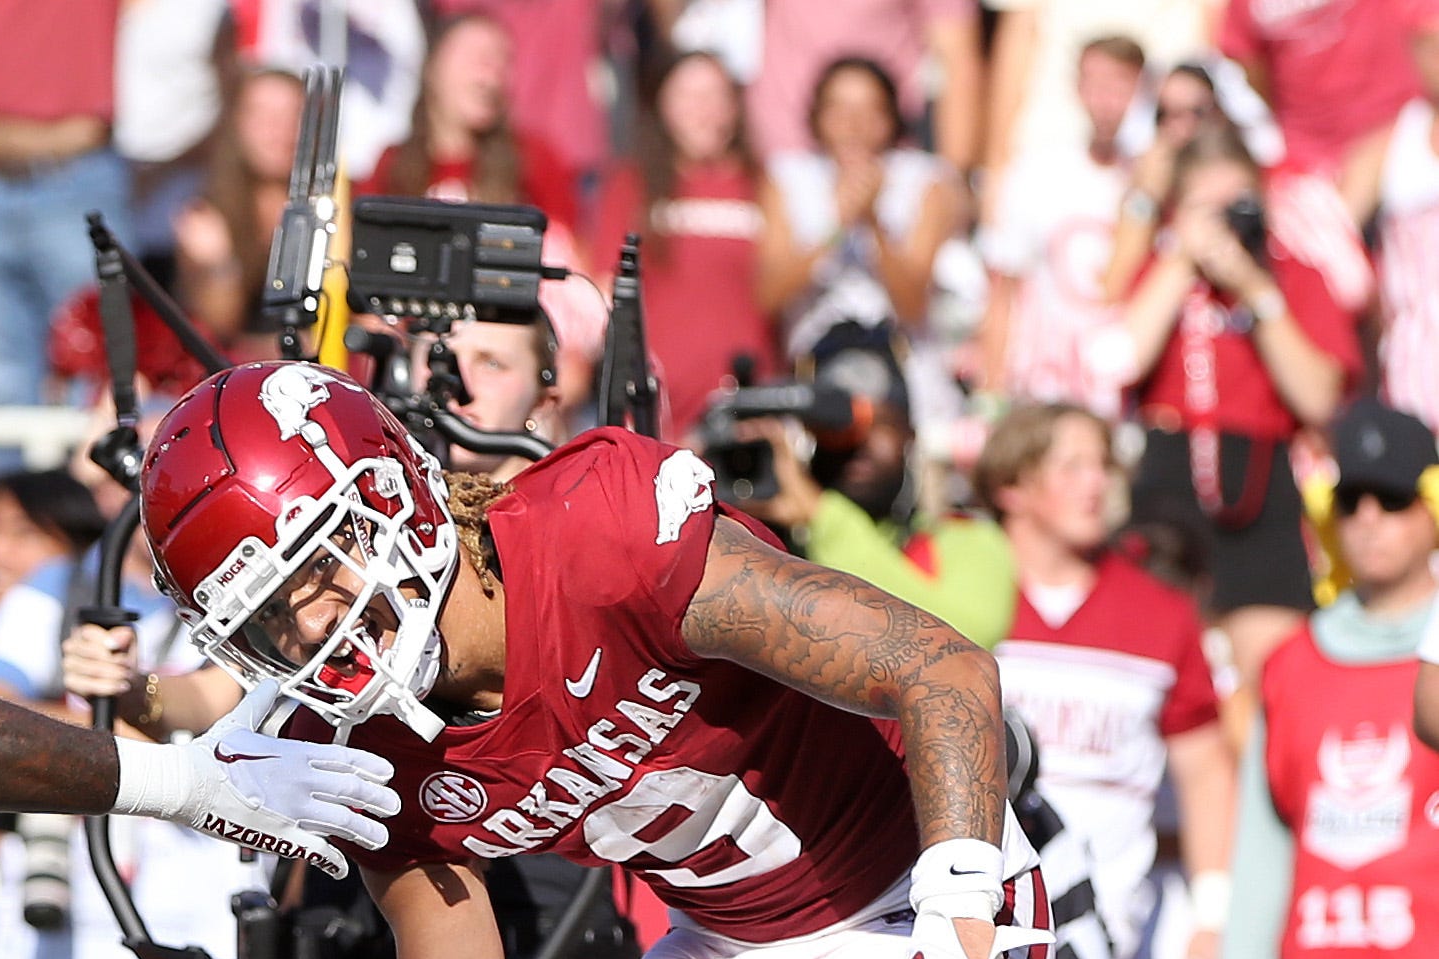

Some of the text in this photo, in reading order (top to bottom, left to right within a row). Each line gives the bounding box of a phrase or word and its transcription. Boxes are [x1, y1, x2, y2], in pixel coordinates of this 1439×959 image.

[217, 557, 247, 588] HOGS
[425, 774, 481, 820] SEC
[462, 668, 702, 859] ARKANSAS
[582, 766, 802, 888] 9
[1295, 884, 1416, 951] 115
